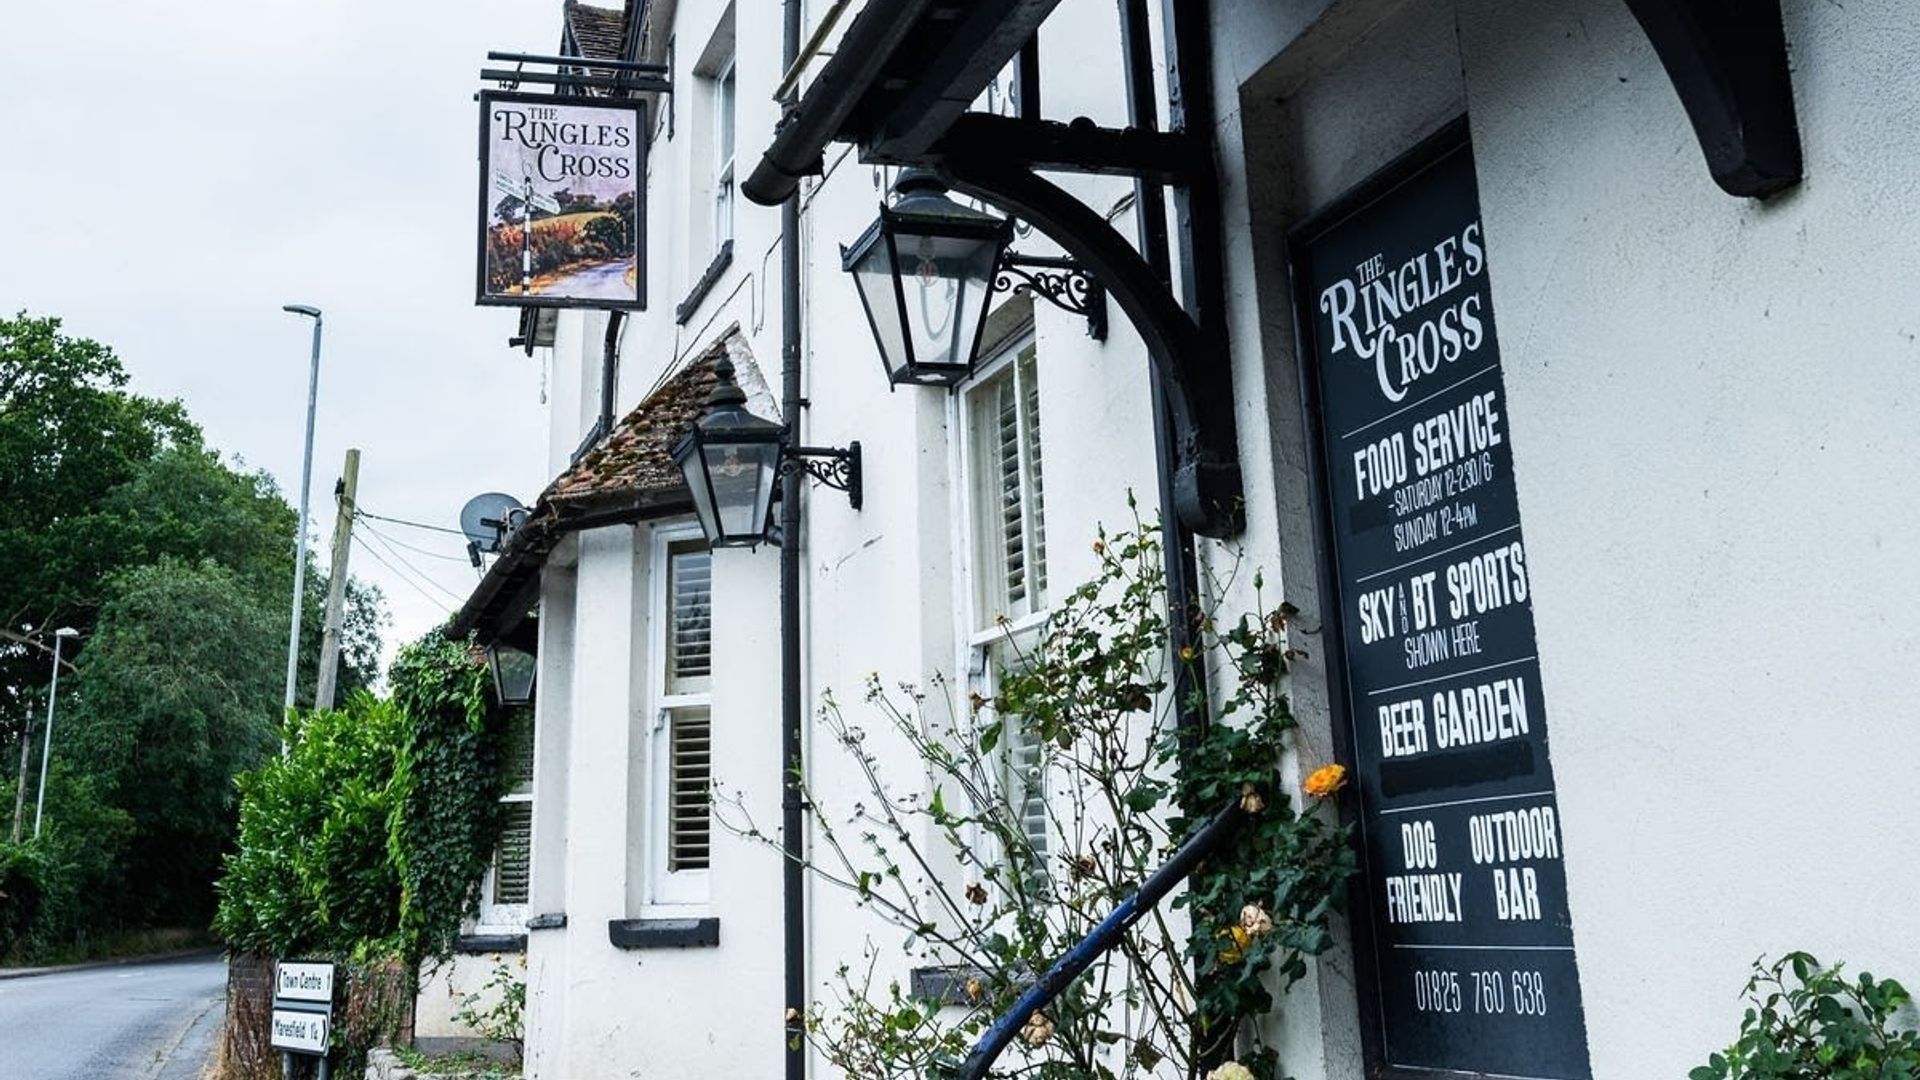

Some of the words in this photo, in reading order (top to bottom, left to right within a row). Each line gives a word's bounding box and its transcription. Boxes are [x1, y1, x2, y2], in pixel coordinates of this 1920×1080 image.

[494, 110, 631, 149] RINGLES
[528, 107, 558, 120] THE
[537, 144, 631, 182] CROSS
[1320, 221, 1483, 359] RINGLES
[1356, 253, 1385, 286] THE
[1375, 292, 1484, 403] CROSS
[1354, 432, 1408, 500] FOOD
[1412, 390, 1502, 477] SERVICE
[1393, 510, 1438, 552] SUNDAY
[1440, 501, 1478, 537] 12-4PM
[1358, 586, 1395, 645] SKY
[1411, 571, 1437, 631] BT
[1446, 541, 1528, 620] SPORTS
[1404, 628, 1449, 670] SHOWN
[1451, 621, 1482, 657] HERE
[1378, 699, 1428, 758] BEER
[1432, 677, 1529, 750] GARDEN
[1401, 820, 1437, 870] DOG
[1469, 806, 1559, 864] OUTDOOR
[1386, 872, 1462, 923] FRIENDLY
[1493, 867, 1541, 921] BAR
[283, 971, 298, 989] Town
[299, 971, 322, 990] Centre
[1415, 970, 1461, 1012] 01825
[1471, 970, 1505, 1013] 760
[1511, 970, 1546, 1015] 638
[274, 1019, 306, 1039] Maresfield
